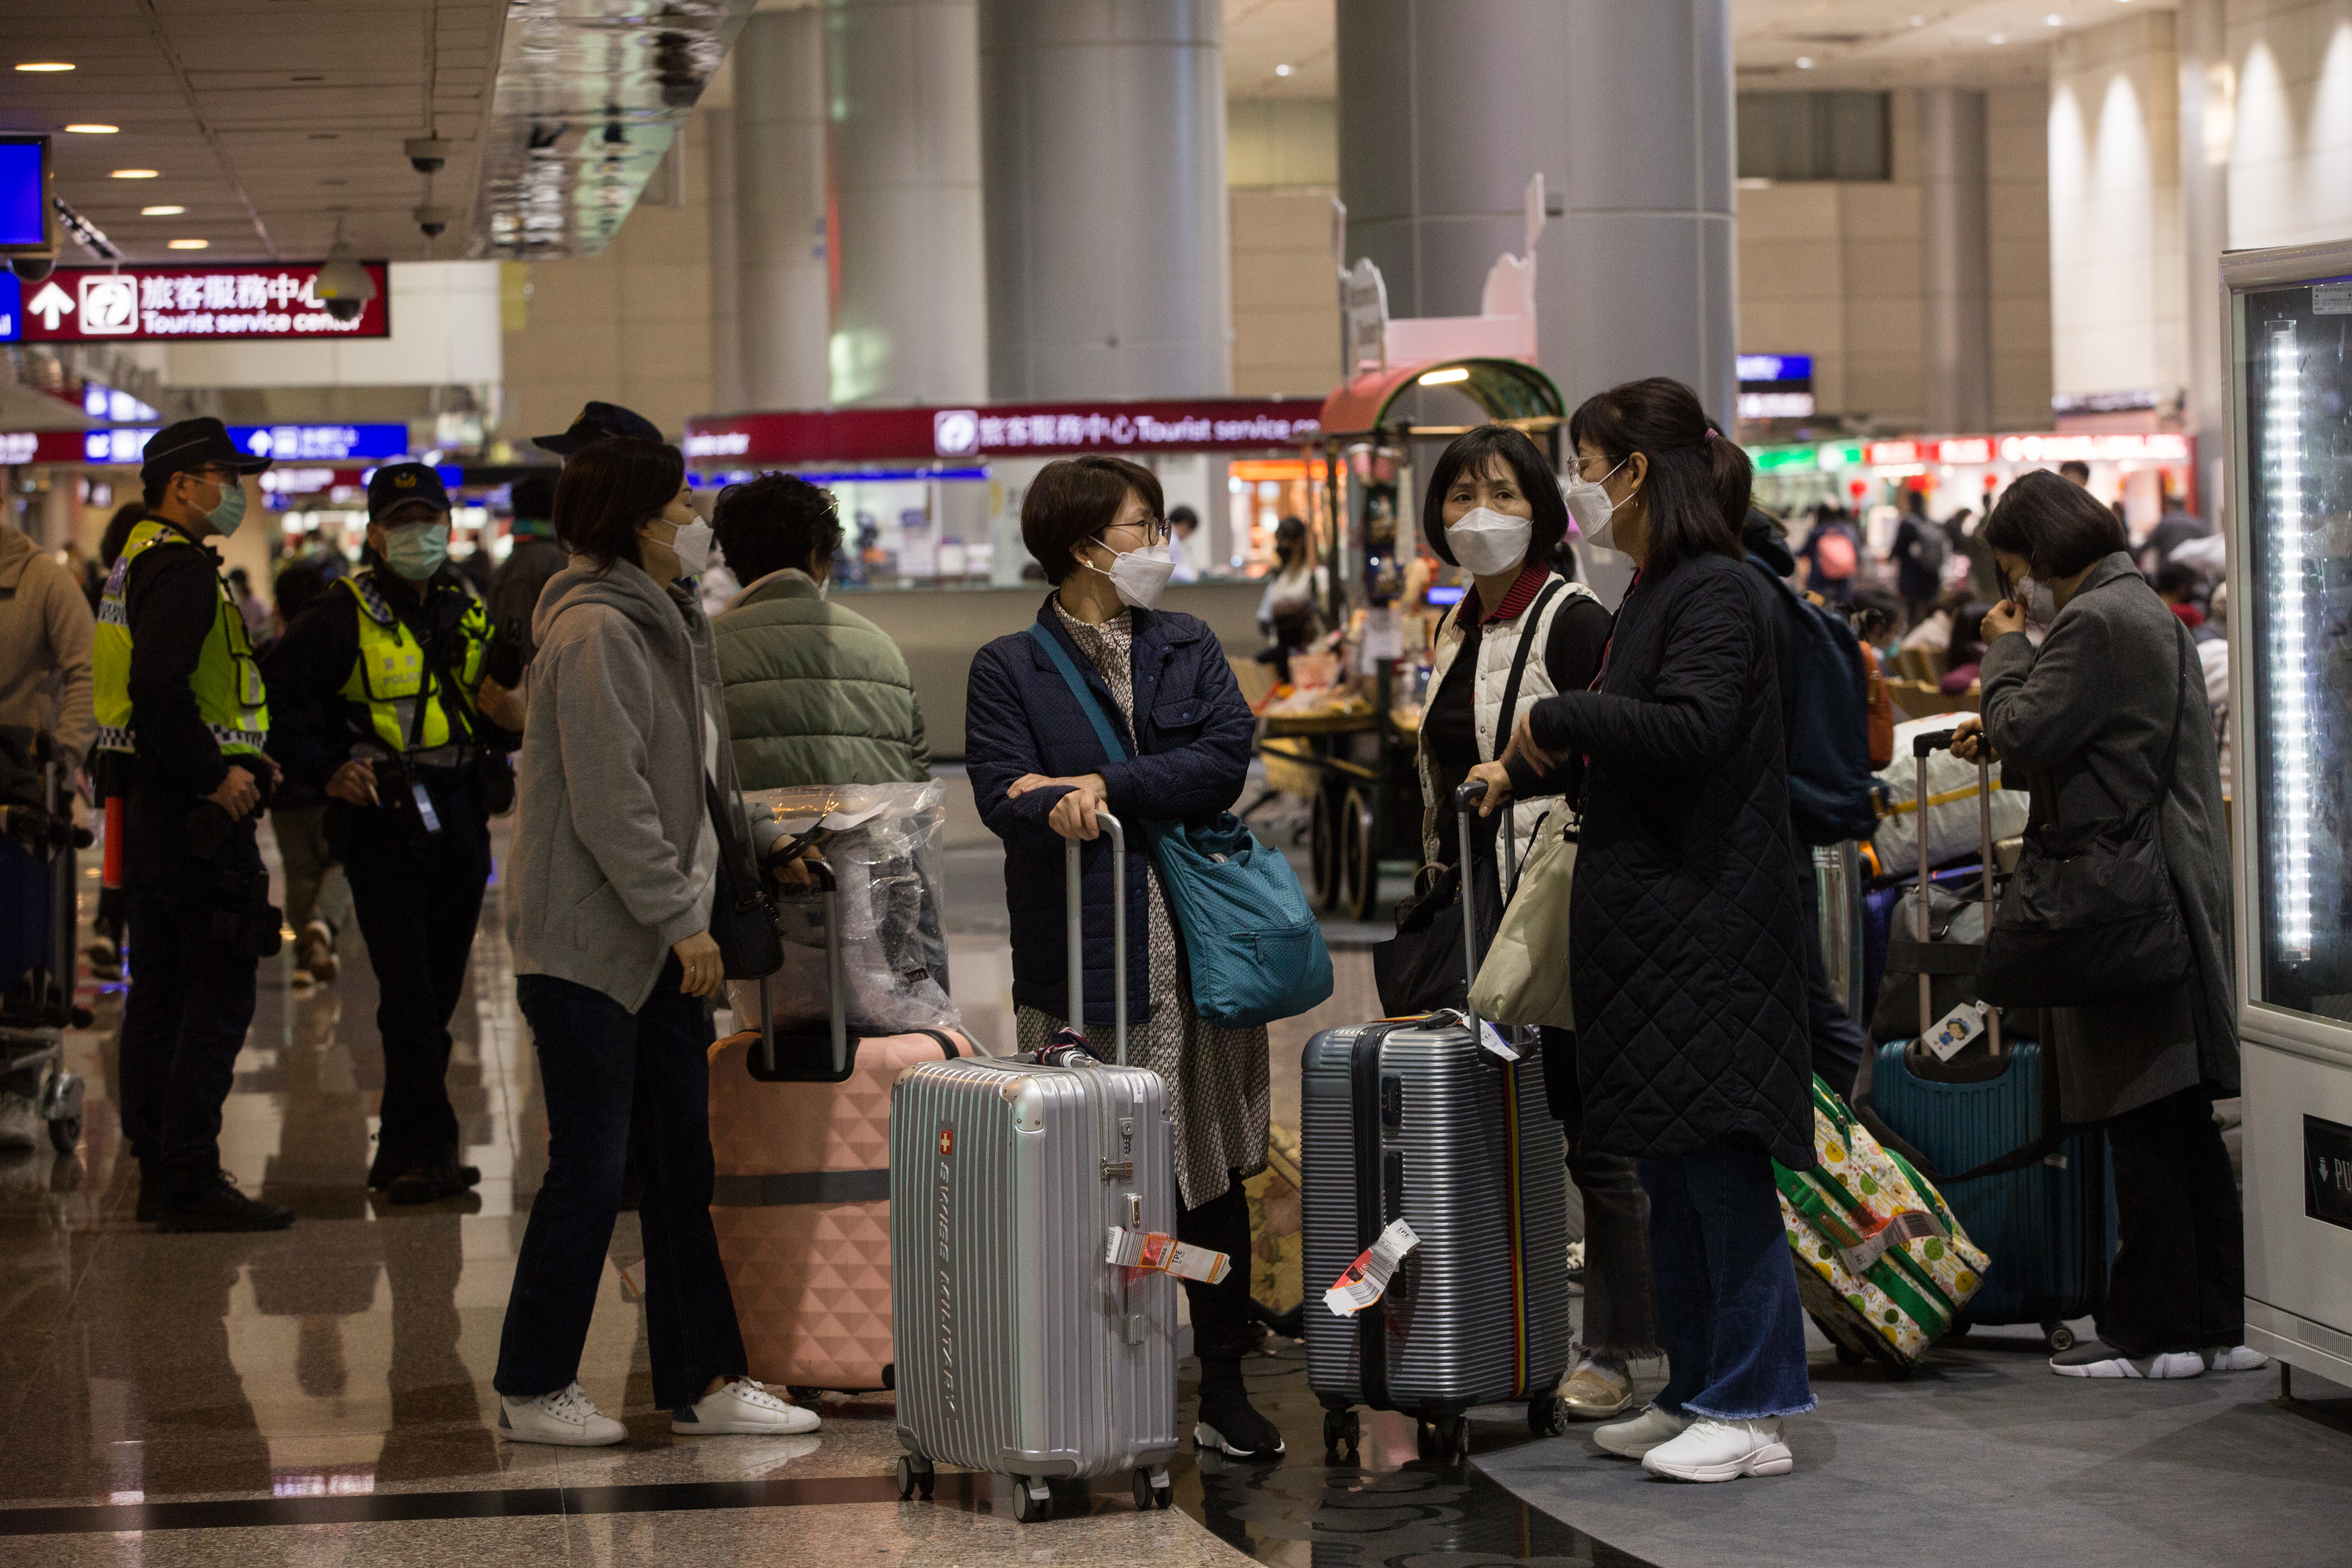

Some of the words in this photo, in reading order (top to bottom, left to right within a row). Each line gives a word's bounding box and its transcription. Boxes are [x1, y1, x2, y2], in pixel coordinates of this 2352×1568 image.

[141, 310, 214, 333] Tourist
[215, 309, 291, 332] service
[1132, 415, 1212, 442] Tourist
[1214, 414, 1290, 441] service
[383, 672, 422, 686] POLIC
[2334, 1158, 2352, 1193] PU
[940, 1161, 950, 1264] SWISS
[1399, 1227, 1410, 1237] TPE
[1172, 1250, 1182, 1263] TPE
[940, 1270, 956, 1414] MILITARY
